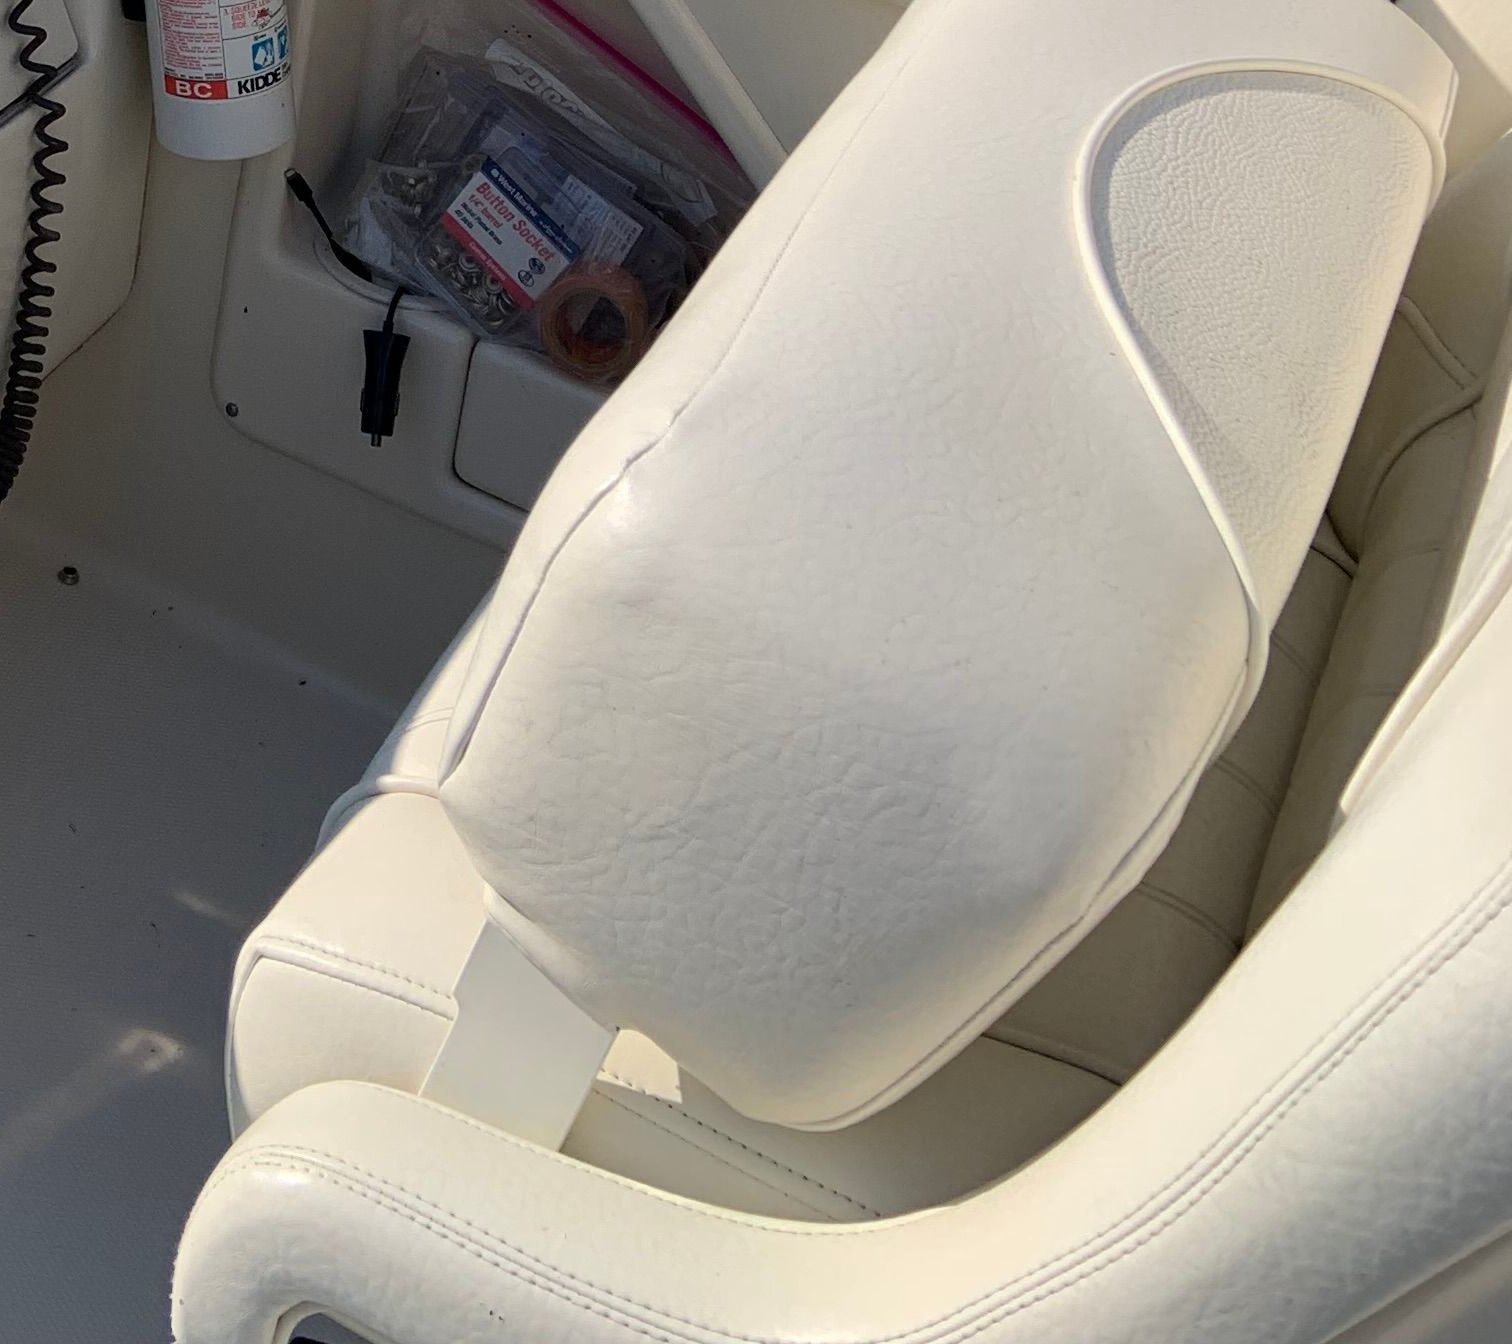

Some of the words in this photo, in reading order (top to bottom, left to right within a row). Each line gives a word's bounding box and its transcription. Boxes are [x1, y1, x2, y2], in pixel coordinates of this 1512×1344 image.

[175, 80, 212, 98] BC
[238, 67, 281, 95] KIDDE
[498, 174, 515, 195] West
[476, 182, 514, 222] Button
[513, 219, 556, 262] Socket
